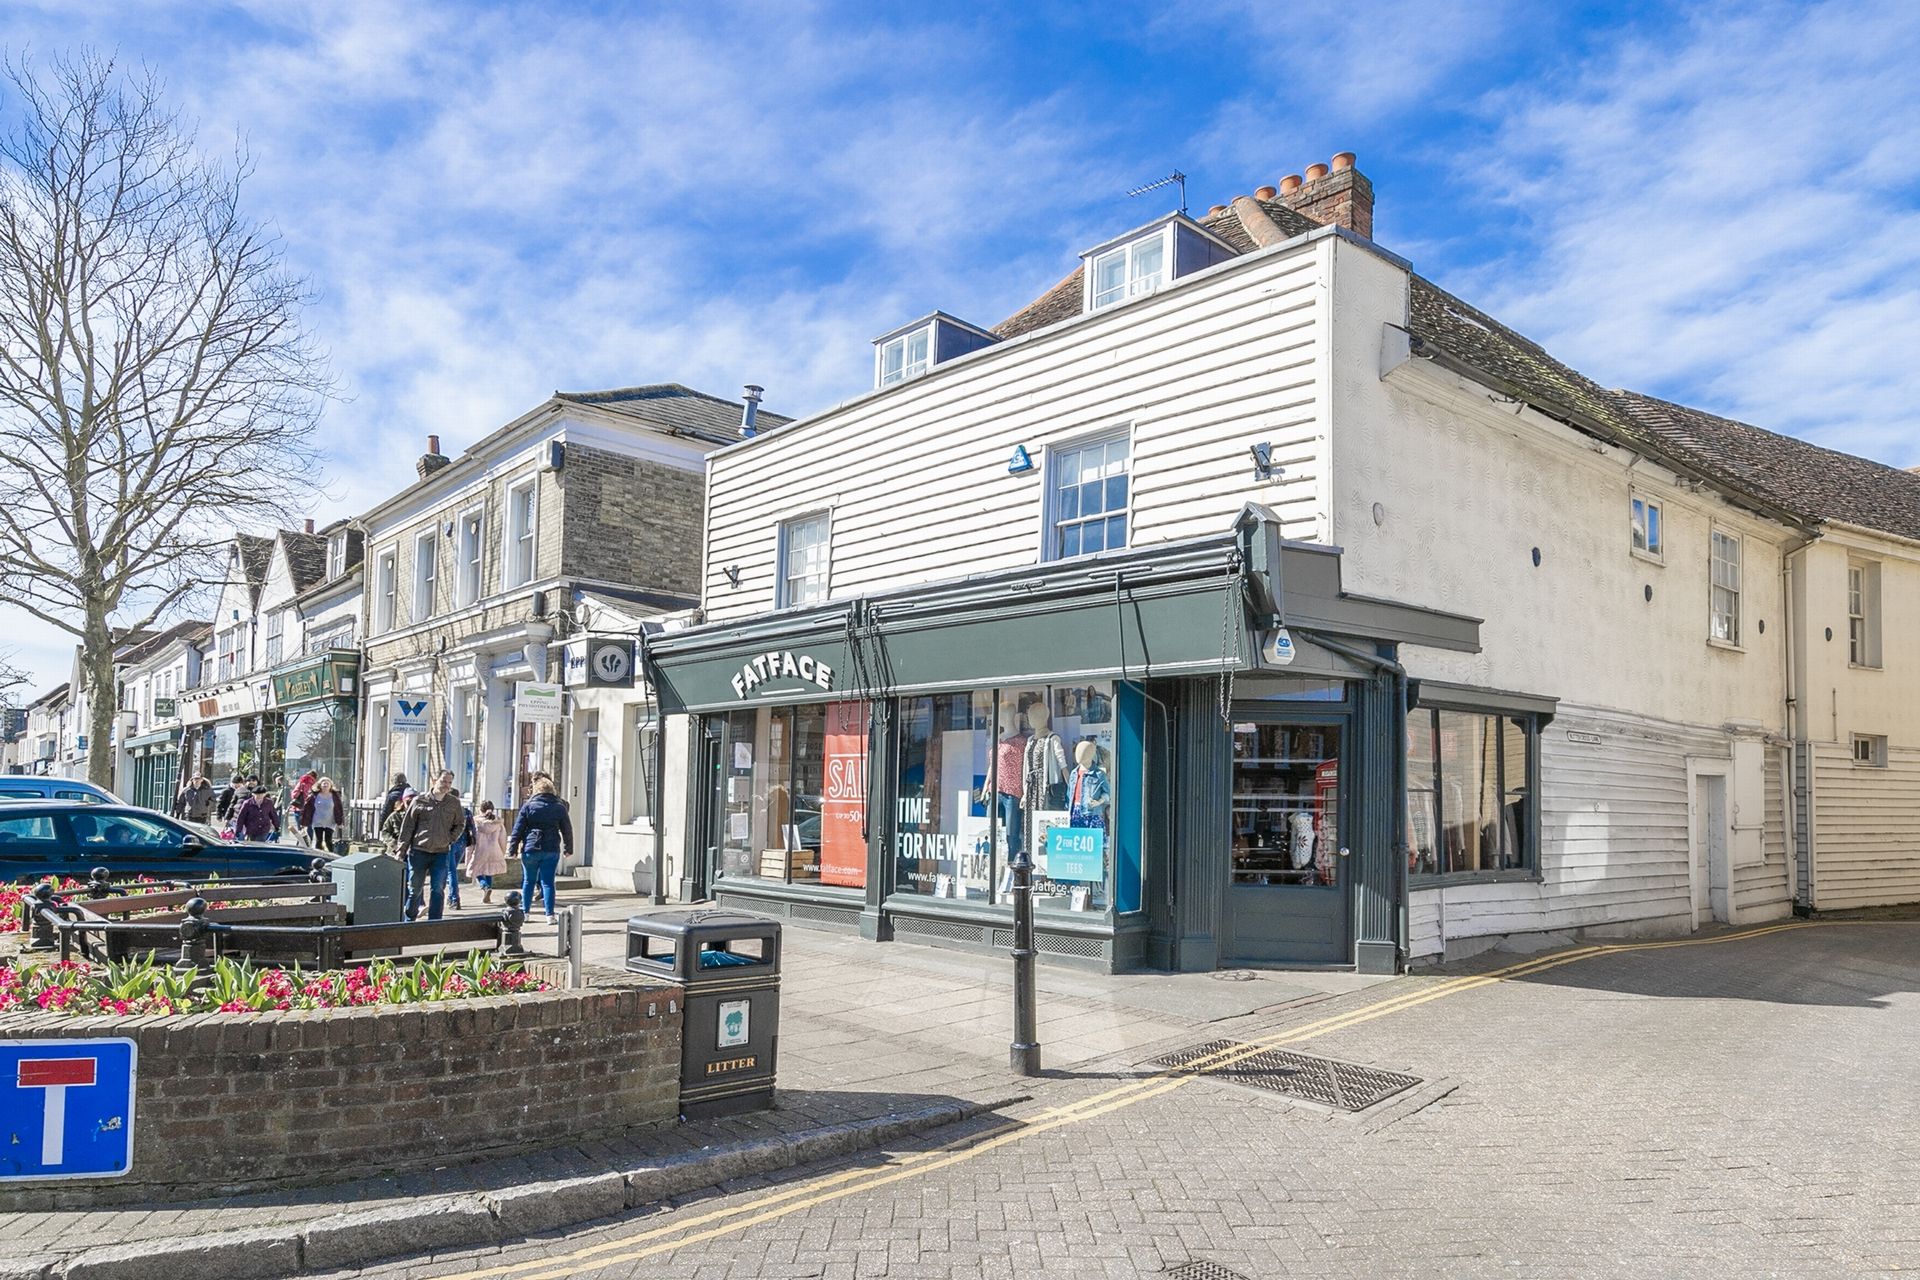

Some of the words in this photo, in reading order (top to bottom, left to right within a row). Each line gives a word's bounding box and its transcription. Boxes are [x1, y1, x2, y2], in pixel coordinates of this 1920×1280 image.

[731, 651, 833, 700] FATFACE
[828, 759, 866, 798] SAL
[897, 797, 931, 824] TIME
[895, 832, 924, 859] FOR
[925, 833, 960, 861] NEW
[1056, 834, 1063, 851] 2
[1063, 839, 1073, 848] FOR
[1073, 835, 1094, 853] £40
[1066, 862, 1084, 874] TEES
[707, 1057, 755, 1073] LITTER
